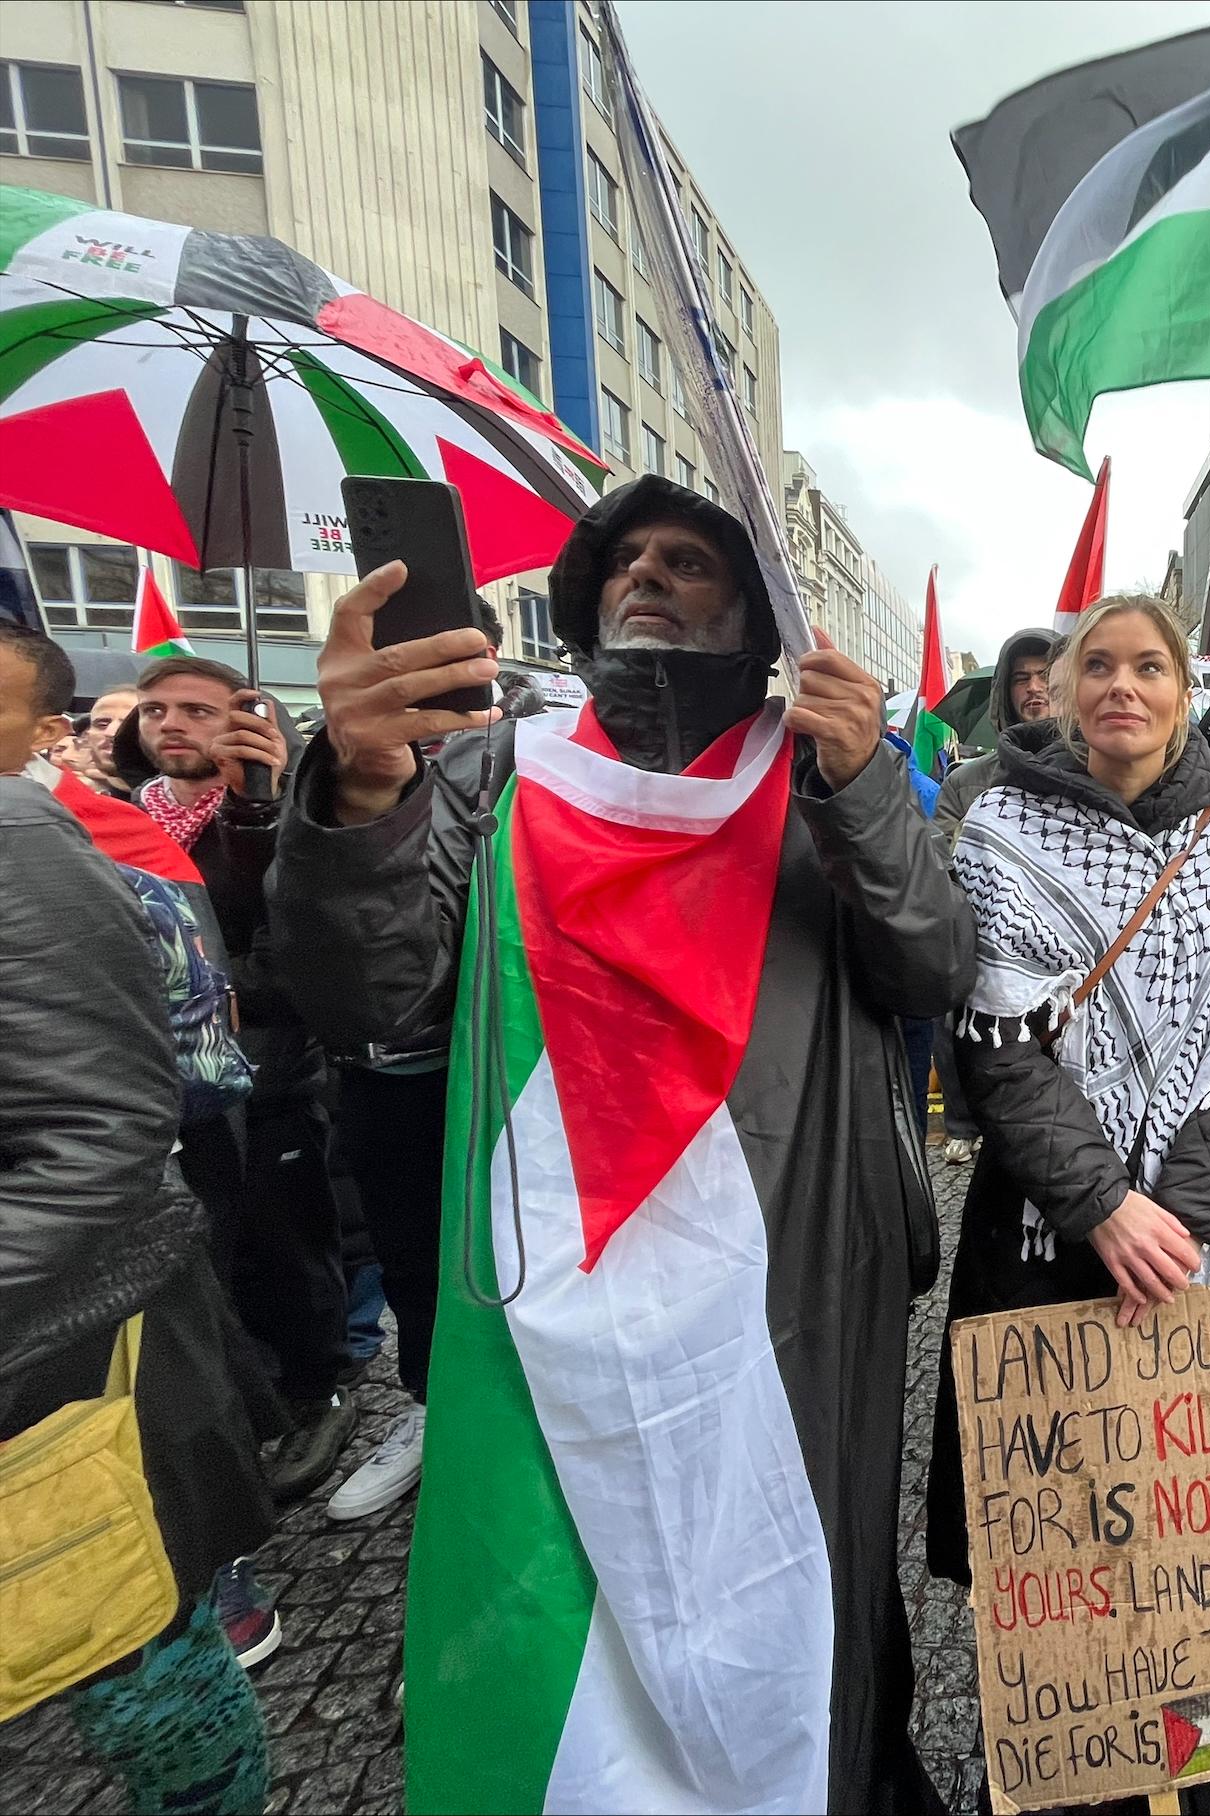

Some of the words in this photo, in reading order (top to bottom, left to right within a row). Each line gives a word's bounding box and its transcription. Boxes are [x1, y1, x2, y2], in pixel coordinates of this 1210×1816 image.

[62, 249, 142, 273] FREE
[75, 234, 156, 259] WILL
[87, 245, 128, 263] BE
[972, 1320, 1112, 1404] LAND
[977, 1410, 1085, 1481] HAVE
[1086, 1403, 1142, 1464] TO
[979, 1487, 1078, 1560] FOR
[1104, 1637, 1197, 1700] HAVE
